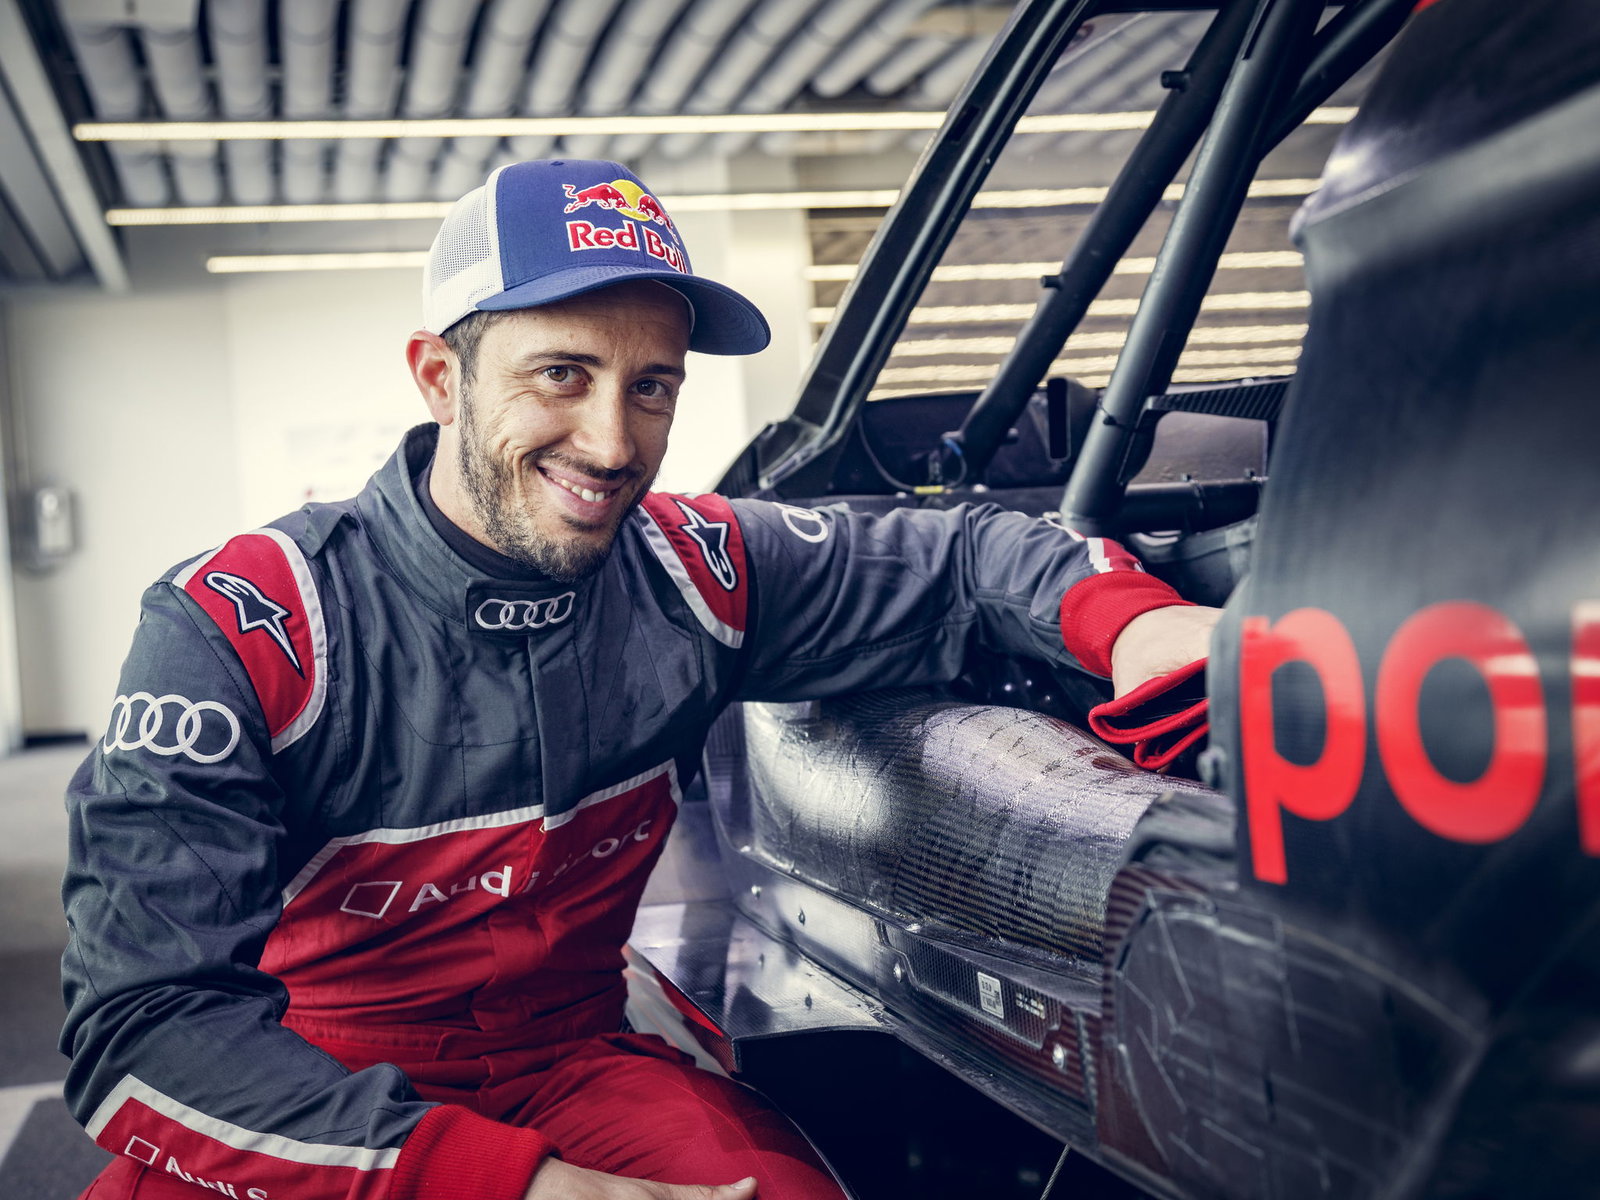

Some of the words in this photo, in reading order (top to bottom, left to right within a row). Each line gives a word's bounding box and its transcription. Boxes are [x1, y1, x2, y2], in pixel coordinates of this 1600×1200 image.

[566, 220, 640, 252] Red
[642, 225, 688, 274] Bull
[408, 865, 540, 913] Audi
[165, 1156, 239, 1200] Audi
